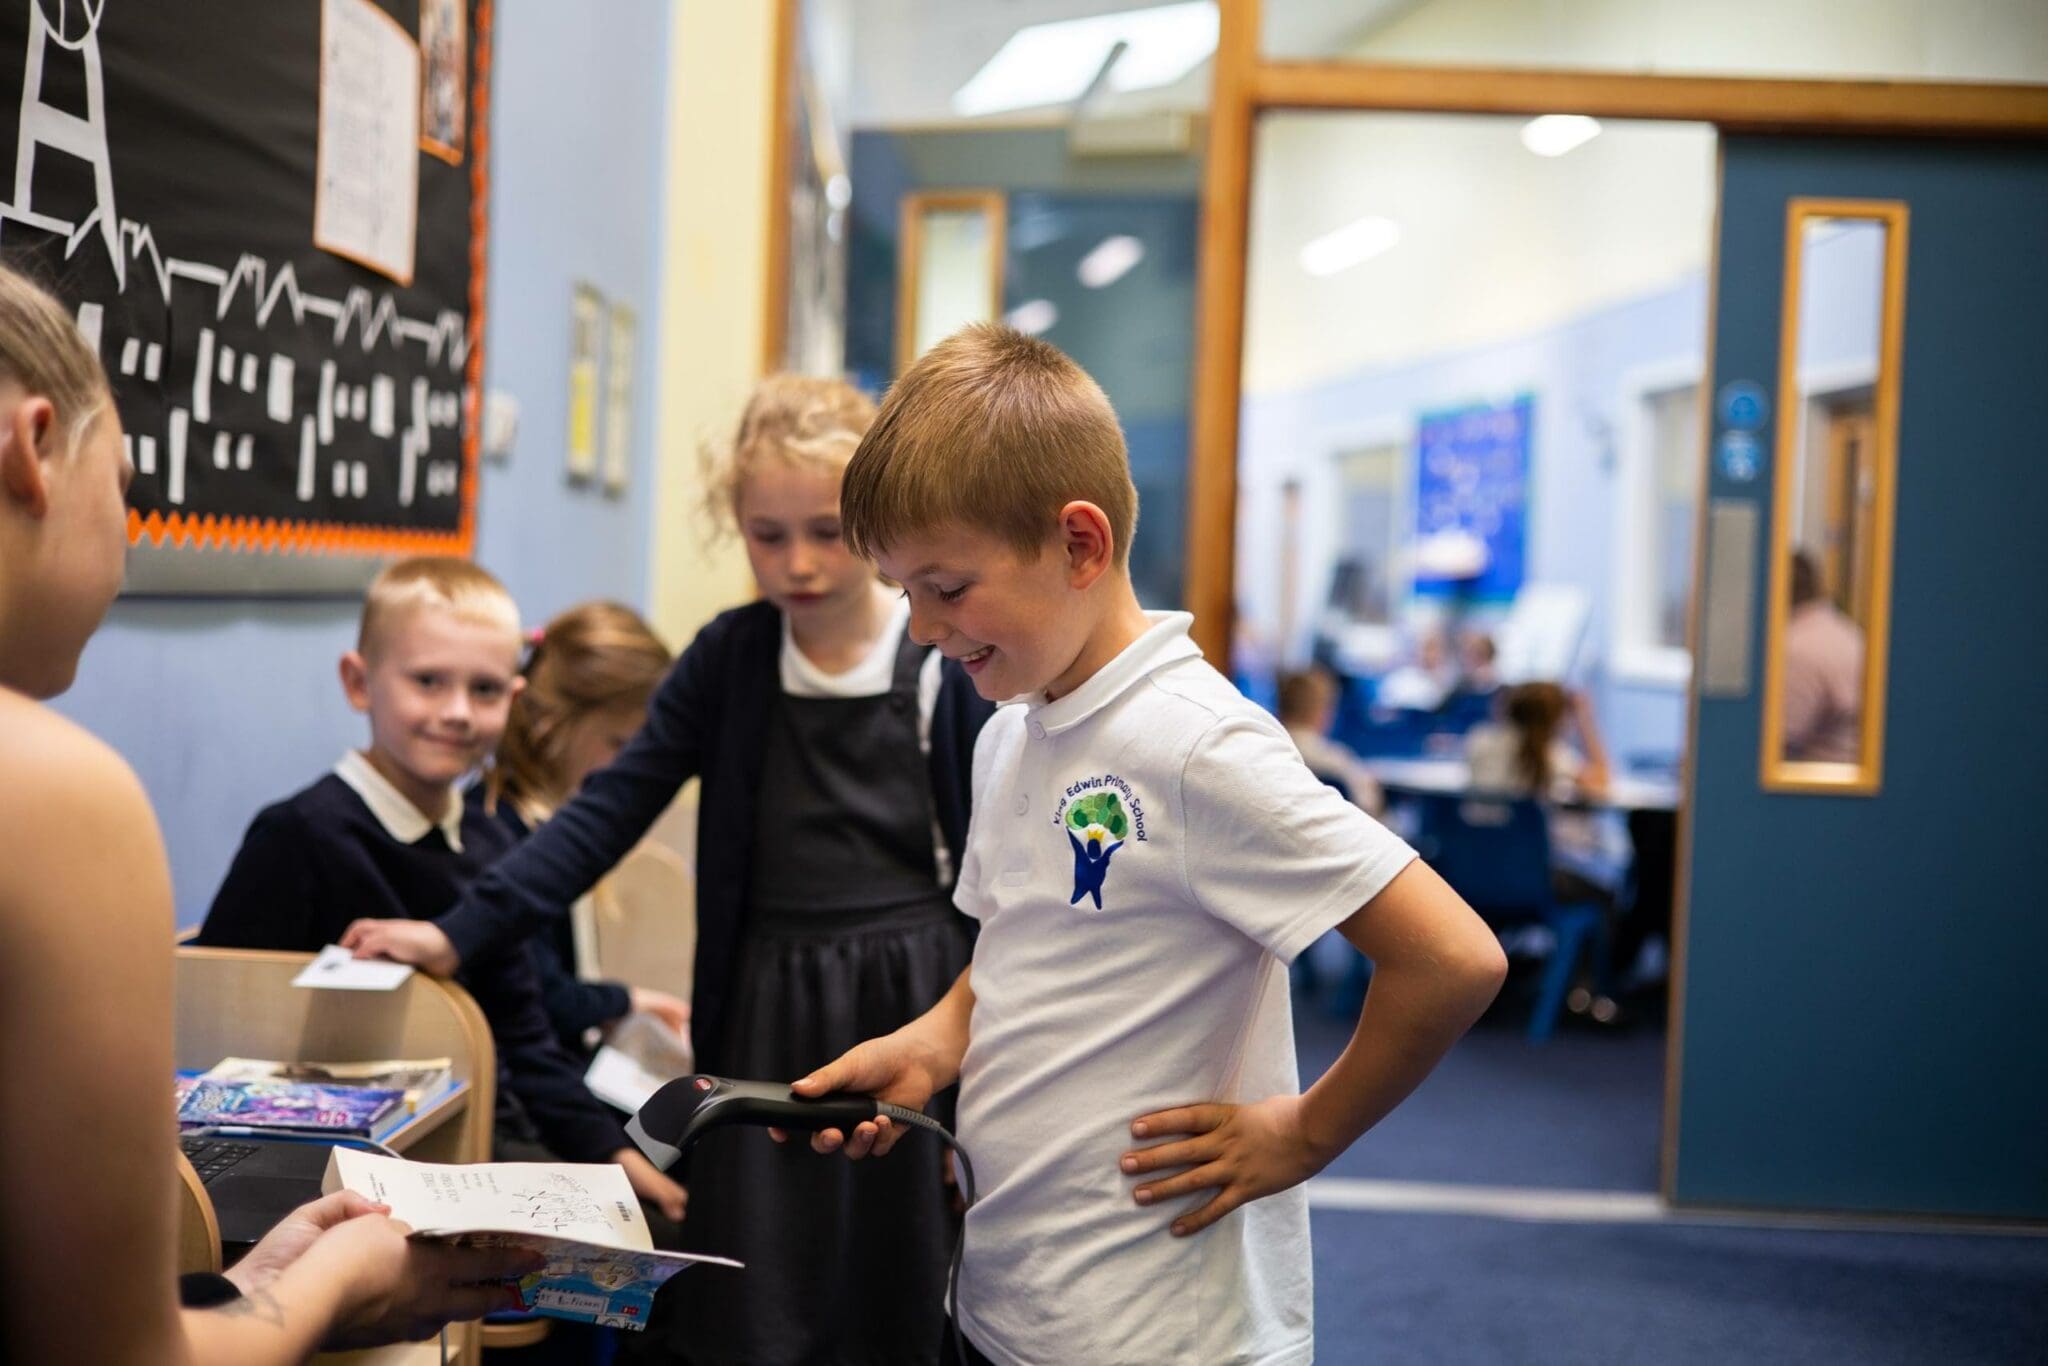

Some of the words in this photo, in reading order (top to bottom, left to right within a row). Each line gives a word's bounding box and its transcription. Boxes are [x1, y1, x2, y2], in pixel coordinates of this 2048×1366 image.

[1066, 777, 1102, 797] Edwin
[1104, 774, 1133, 801] Primary
[1129, 798, 1148, 842] School
